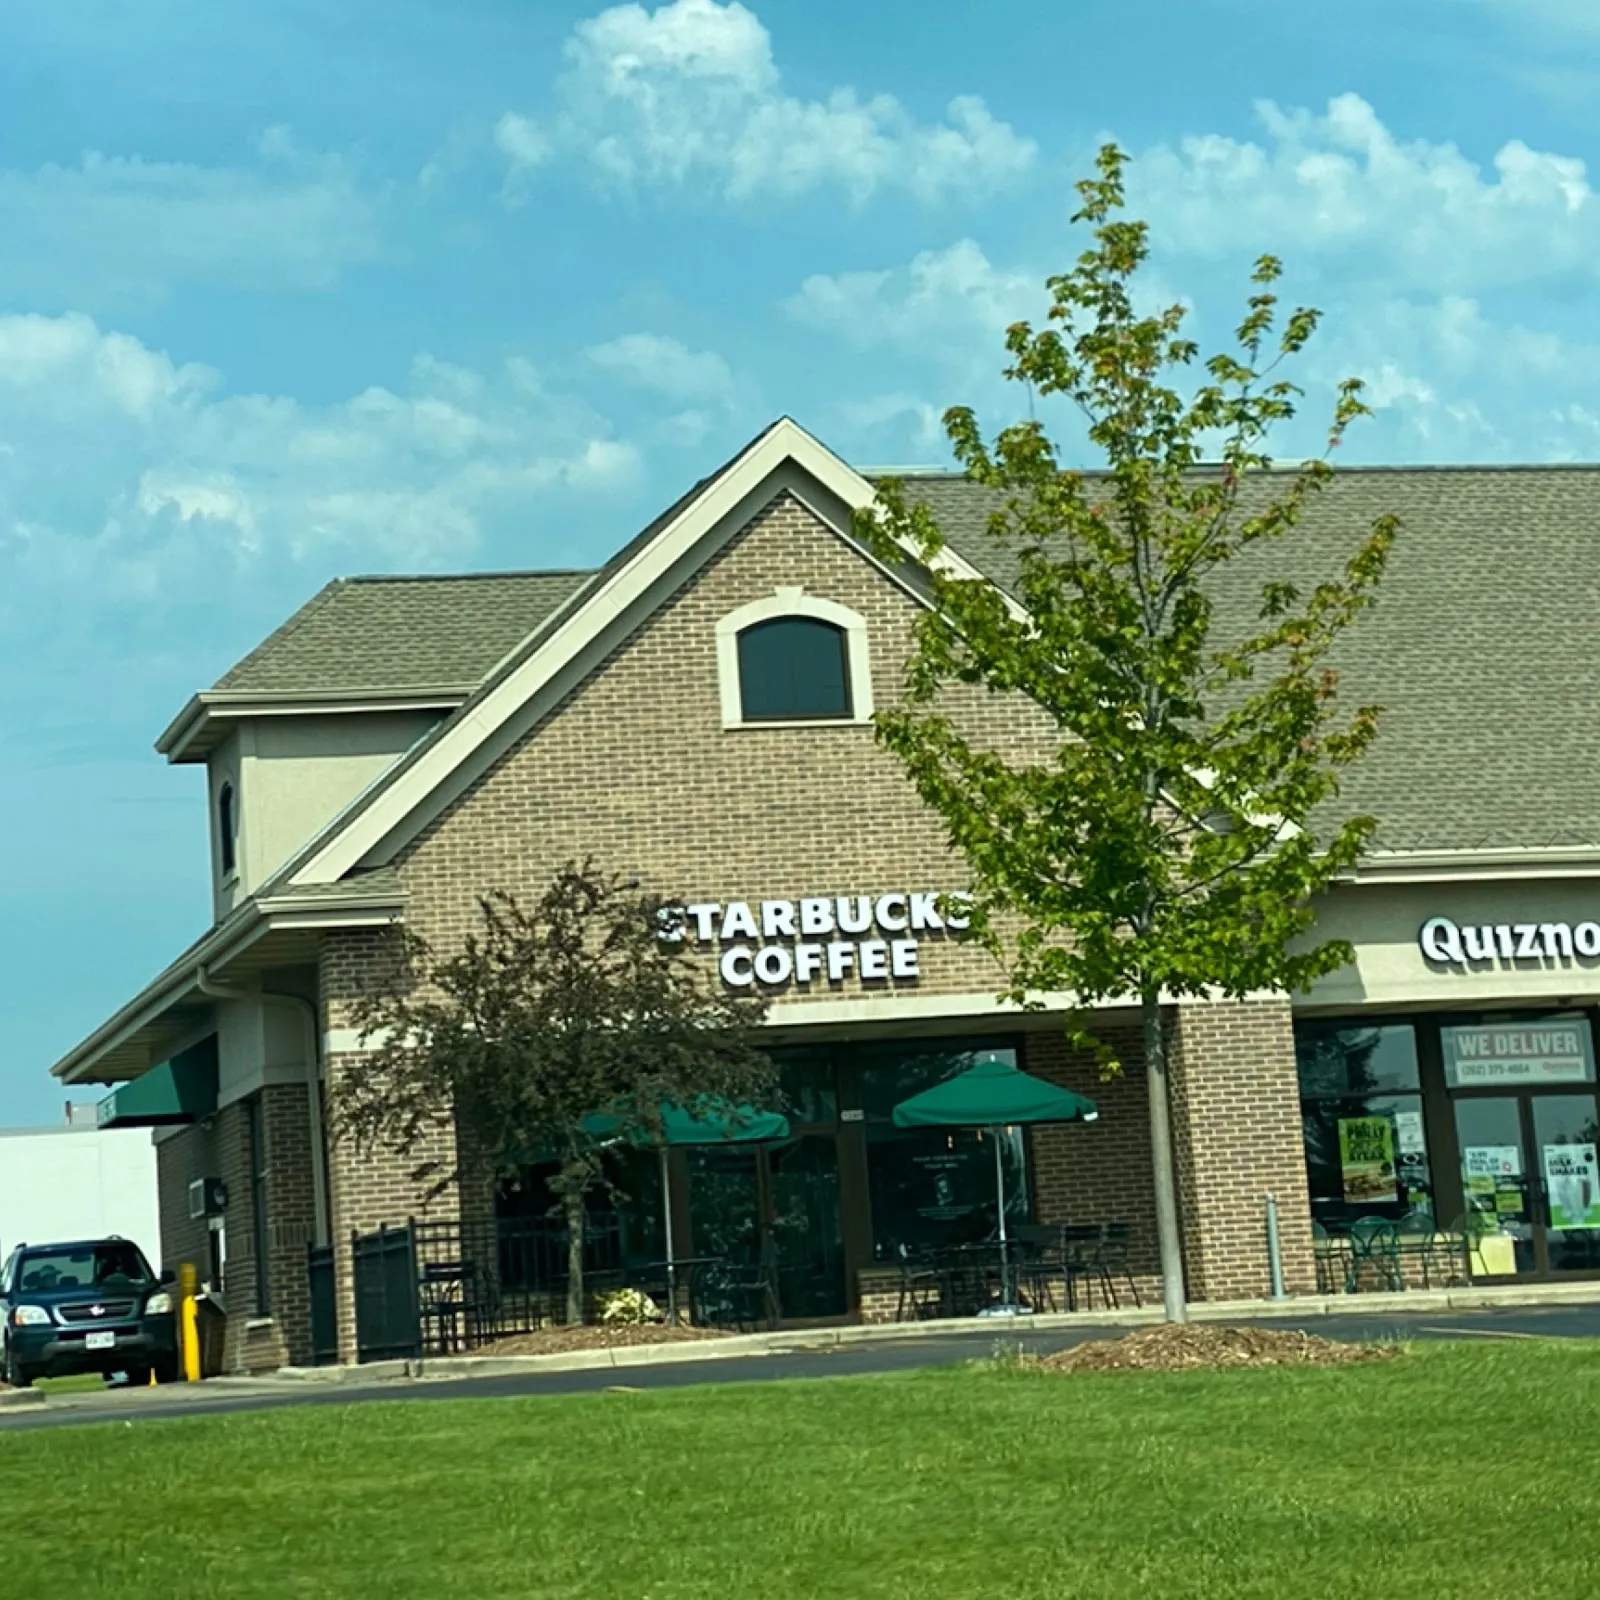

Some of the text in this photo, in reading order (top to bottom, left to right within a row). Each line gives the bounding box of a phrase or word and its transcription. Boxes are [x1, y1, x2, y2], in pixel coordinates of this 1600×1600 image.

[720, 939, 919, 986] COFFEE
[1457, 1031, 1579, 1057] WE DELIVER
